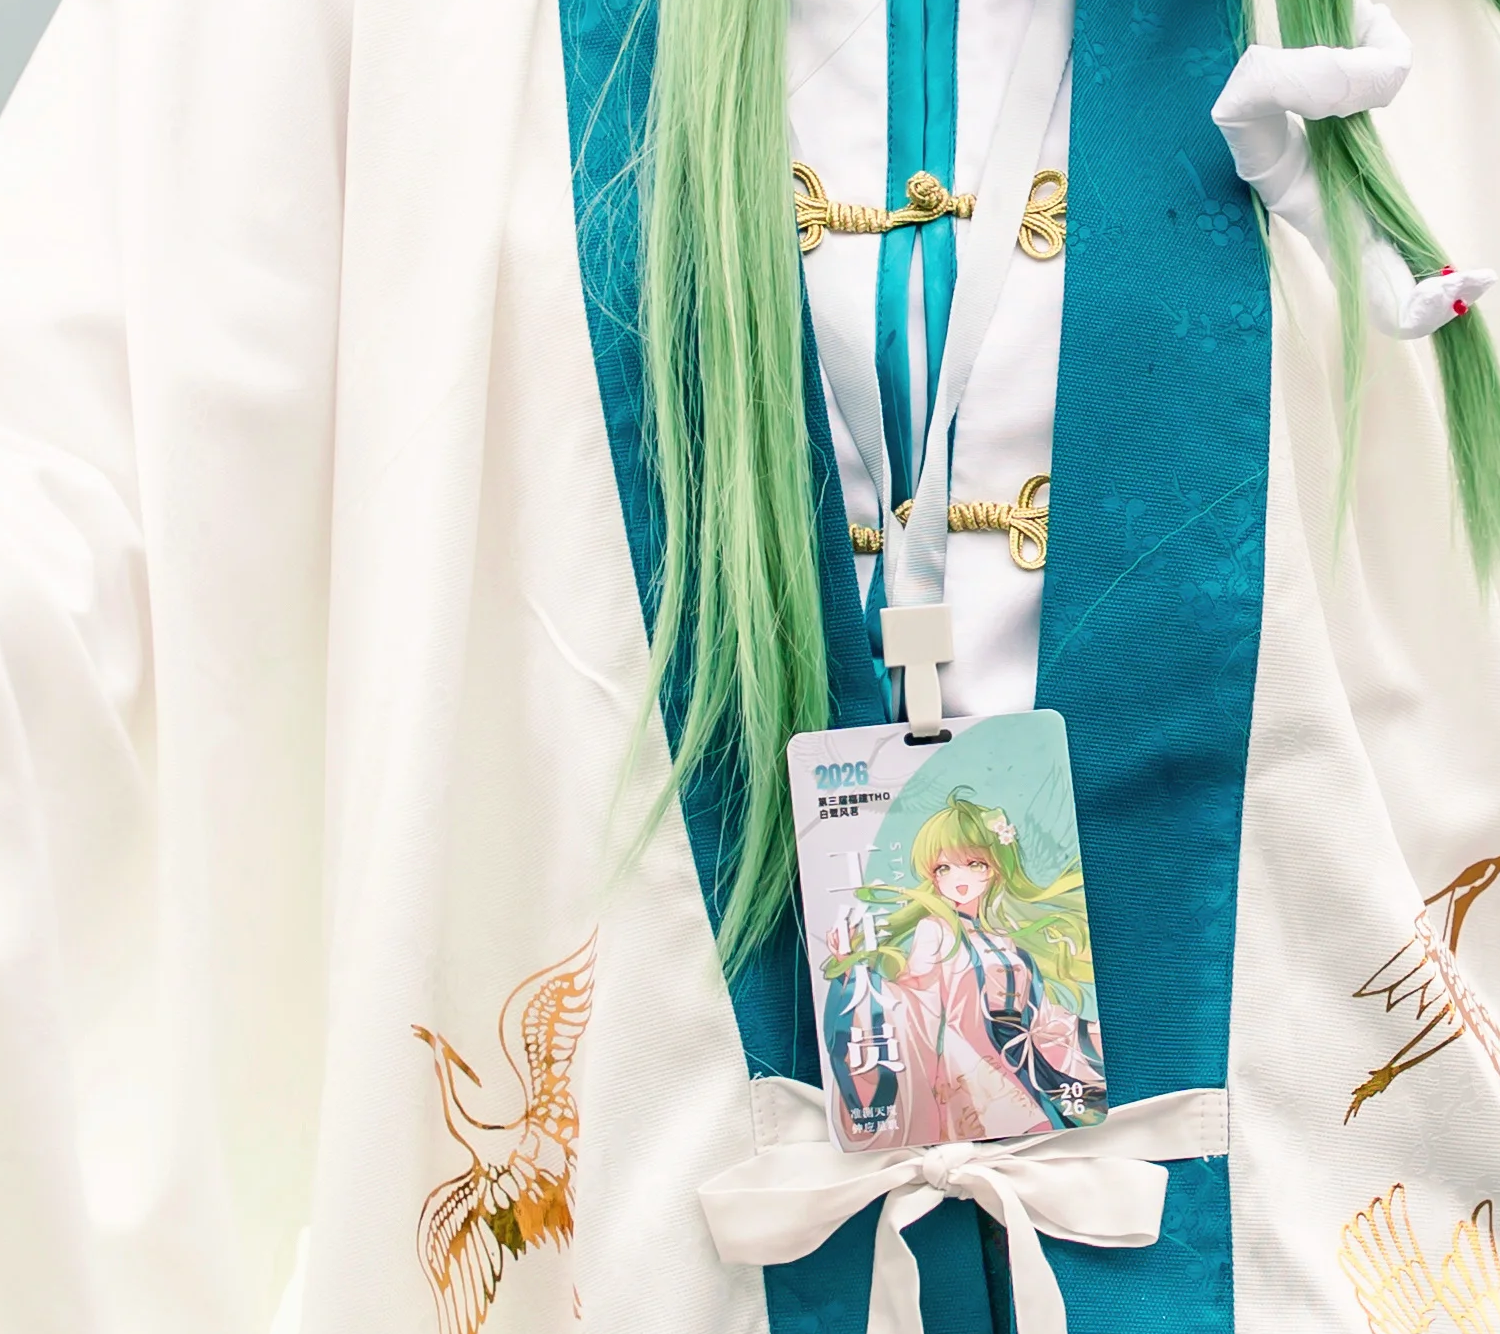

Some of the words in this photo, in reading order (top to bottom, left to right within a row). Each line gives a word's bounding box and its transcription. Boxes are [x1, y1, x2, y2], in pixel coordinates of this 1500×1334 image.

[815, 761, 869, 789] 2026
[826, 843, 906, 1076] 工作人员
